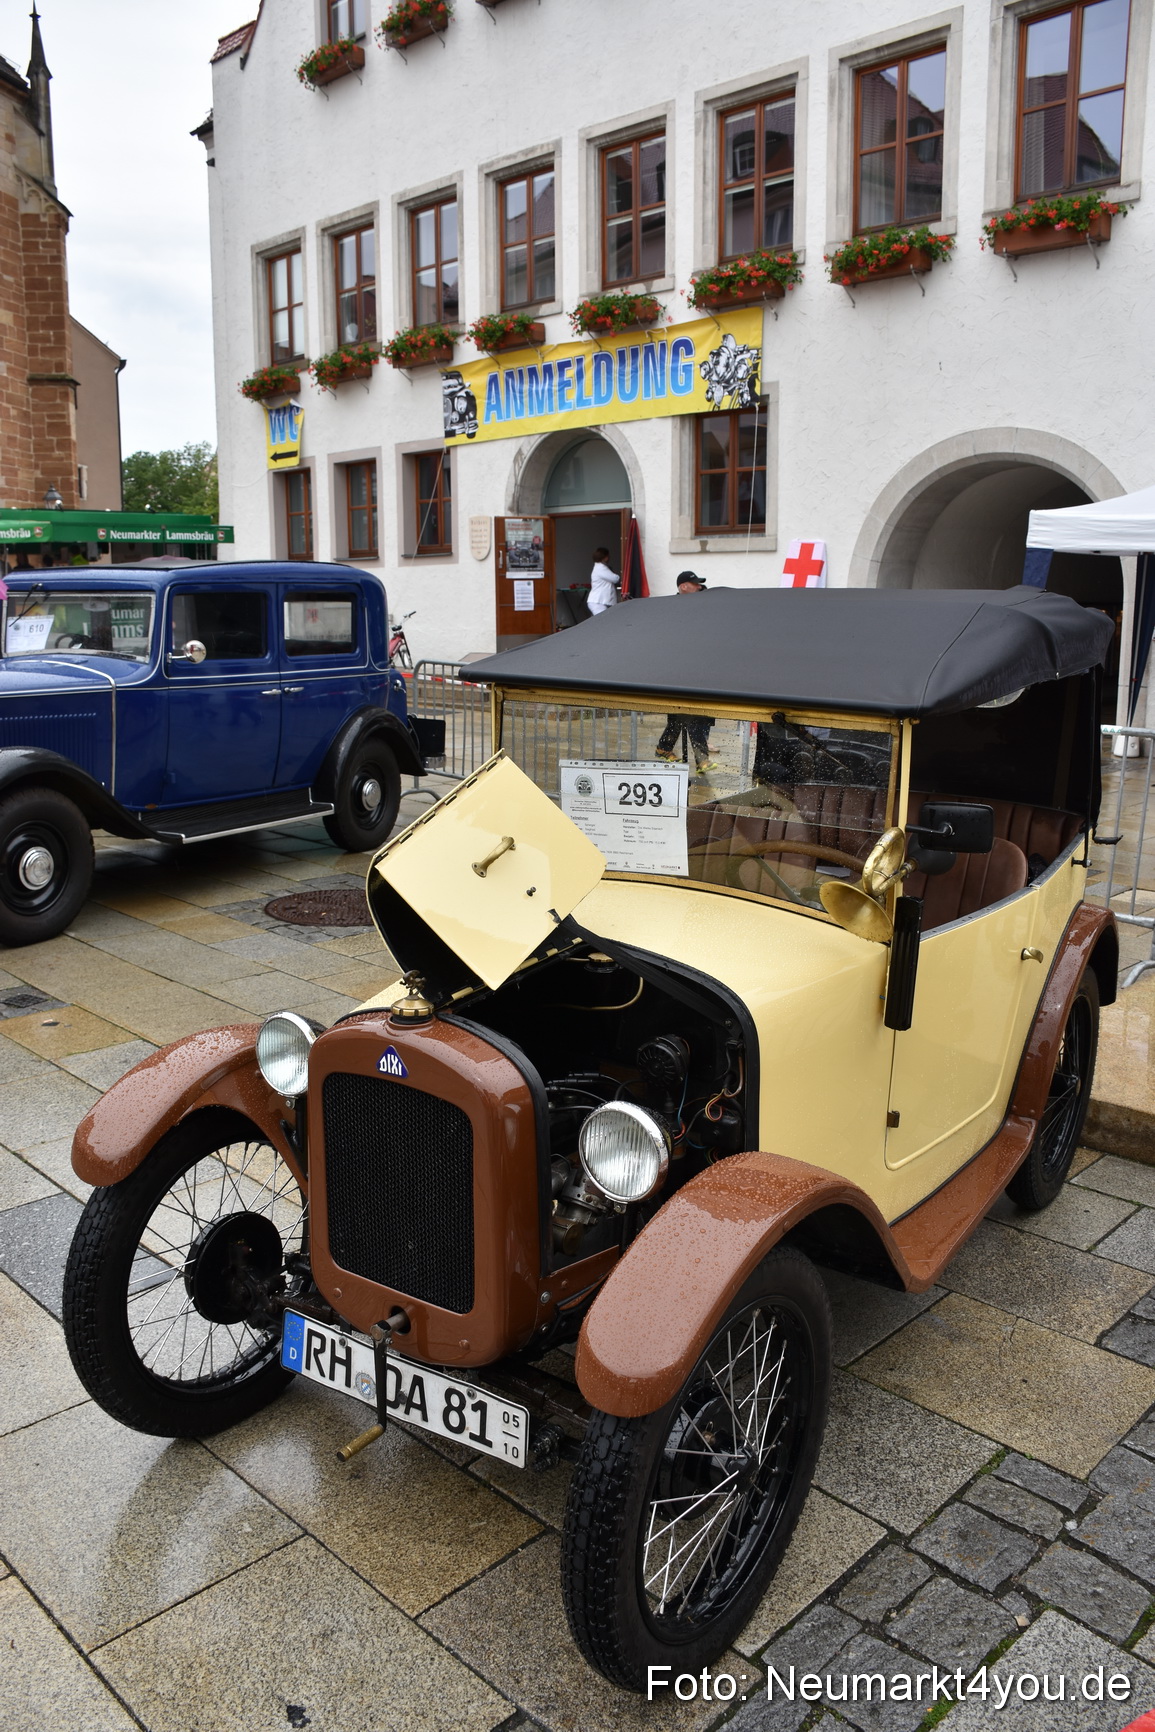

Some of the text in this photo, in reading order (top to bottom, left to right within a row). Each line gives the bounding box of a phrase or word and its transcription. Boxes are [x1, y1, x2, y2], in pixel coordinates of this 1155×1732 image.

[483, 336, 695, 424] ANMELDUNG
[265, 403, 301, 445] WC
[110, 530, 214, 541] Neumarkter Lammsbräu
[29, 624, 45, 633] 610
[618, 782, 663, 808] 293
[379, 1053, 402, 1076] DIXI
[289, 1347, 297, 1360] D
[305, 1327, 493, 1449] RH DA 81
[502, 1410, 520, 1429] 05
[503, 1442, 519, 1459] 10
